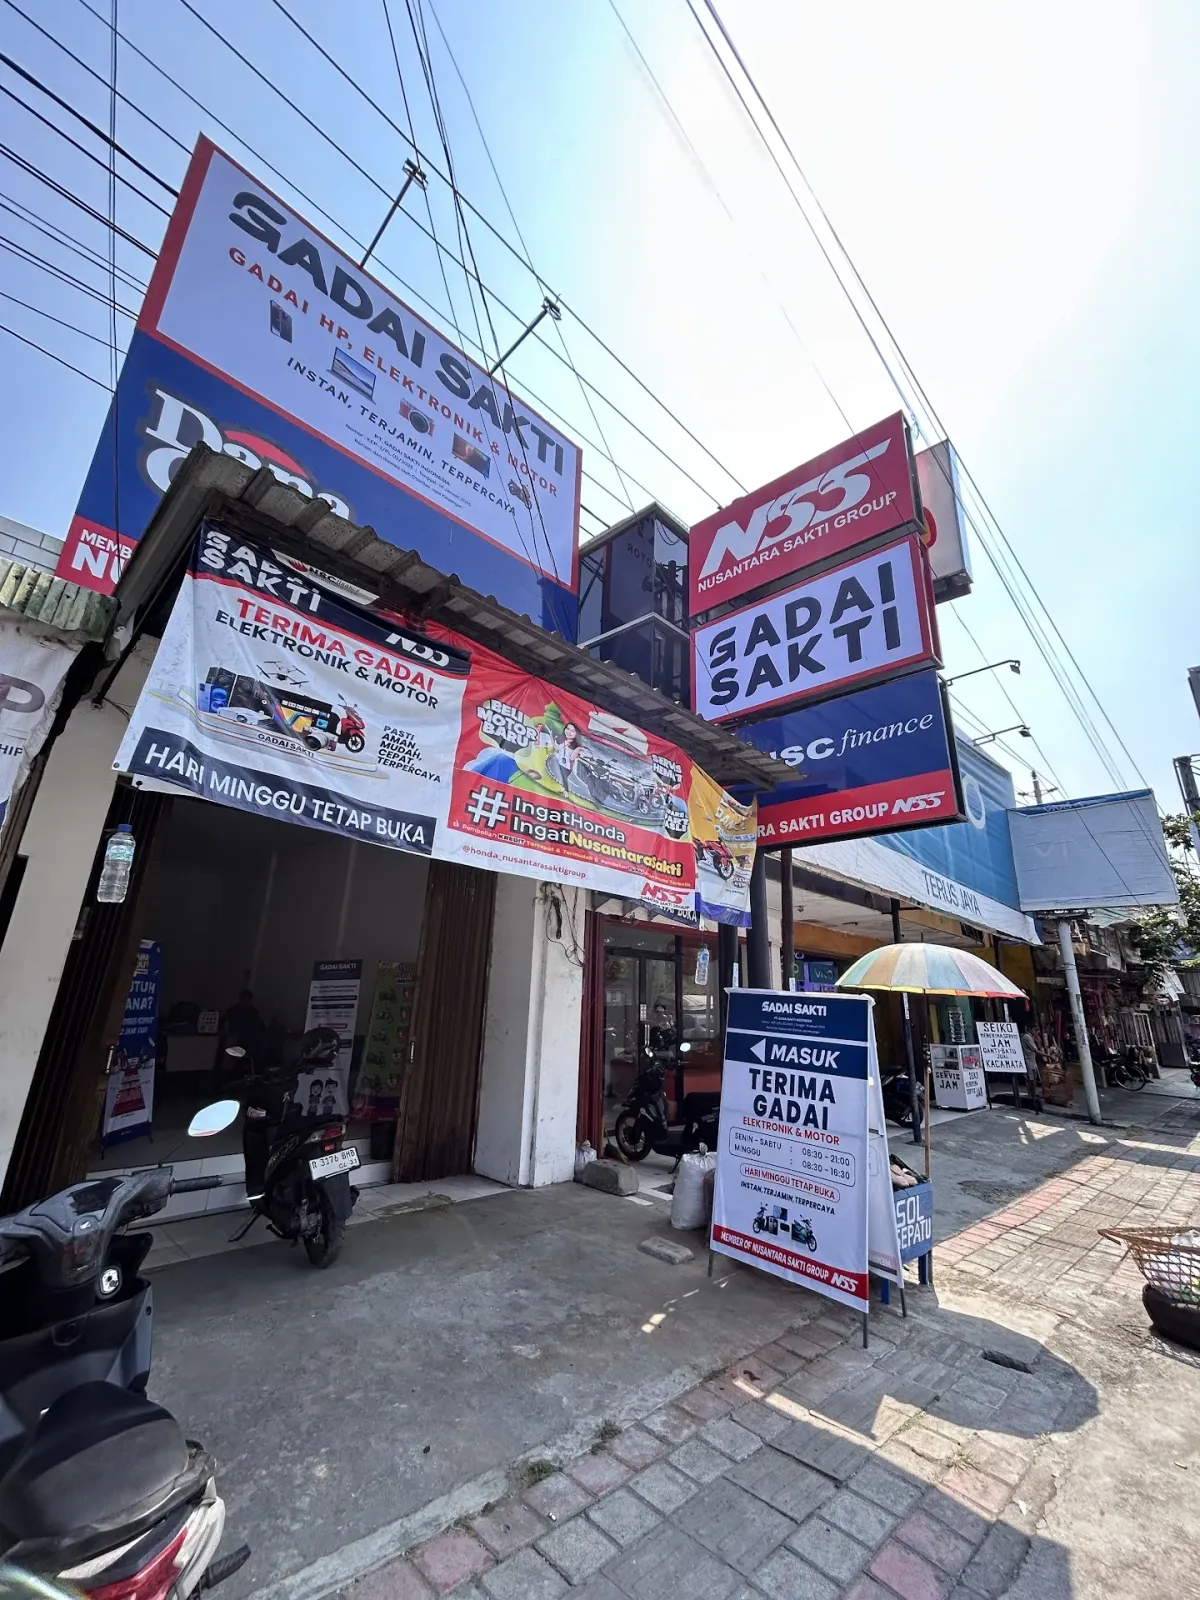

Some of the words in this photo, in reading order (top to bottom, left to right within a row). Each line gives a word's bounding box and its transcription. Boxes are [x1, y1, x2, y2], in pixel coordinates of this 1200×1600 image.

[229, 247, 309, 315] GADAI
[319, 313, 353, 350] HP,
[363, 345, 484, 444] ELEKTRONIK
[490, 441, 500, 456] &
[507, 452, 558, 498] MOTOR
[434, 352, 564, 477] SAKTI
[286, 357, 353, 409] INSTAN,
[359, 405, 436, 464] TERJAMIN,
[441, 459, 517, 518] TERPERCAYA
[697, 545, 781, 593] NUSANTARA
[783, 523, 830, 553] SAKTI
[833, 490, 897, 529] GROUP
[199, 548, 322, 613] SAKTI
[307, 566, 339, 584] NSC
[215, 609, 350, 674] ELEKTRONIK
[354, 666, 371, 682] &
[374, 672, 440, 710] MOTOR
[237, 597, 347, 658] TERIMA
[353, 648, 435, 693] GADAI
[708, 605, 902, 706] SAKTI
[476, 706, 537, 741] MOTOR
[490, 699, 524, 724] BELI
[257, 732, 289, 751] GADAI
[383, 724, 415, 741] PASTI
[482, 720, 529, 748] BARU
[769, 737, 835, 768] SC
[836, 713, 934, 756] finance
[376, 756, 442, 784] TERPERCAYA
[145, 743, 205, 785] HARI
[210, 770, 307, 816] MINGGU
[312, 798, 373, 831] TETAP
[375, 815, 426, 845] BUKA
[461, 823, 498, 839] Pembelian
[498, 834, 525, 845] KREDIT
[514, 797, 626, 843] IngatHonda
[779, 812, 825, 834] SAKTI
[829, 802, 889, 825] GROUP
[462, 844, 587, 880] @honda_nusantarasaktigroup
[920, 869, 959, 908] TERUS
[959, 888, 983, 917] JAYA
[794, 1003, 827, 1017] SAKTI
[983, 1022, 1013, 1033] SEIKO
[990, 1039, 1011, 1048] JAM
[770, 1044, 841, 1069] MASUK
[985, 1059, 1025, 1070] KACAMATA
[748, 1068, 836, 1104] TERIMA
[935, 1071, 960, 1080] SERVIS
[939, 1080, 959, 1090] JAM
[753, 1094, 829, 1130] GADAI
[742, 1116, 793, 1136] ELEKTRONIK
[795, 1127, 803, 1138] &
[804, 1130, 840, 1146] MOTOR
[311, 1160, 318, 1170] R
[734, 1132, 754, 1143] SENIN
[759, 1138, 782, 1150] SABTU
[830, 1154, 850, 1167] 21:00
[734, 1143, 761, 1157] MINGGU
[744, 1167, 760, 1177] HARI
[760, 1170, 790, 1185] MINGGU
[791, 1177, 814, 1194] TETAP
[814, 1187, 835, 1200] BUKA
[896, 1195, 925, 1227] SOL
[720, 1231, 745, 1248] MEMBER
[745, 1238, 752, 1249] OF
[751, 1241, 787, 1265] NUSANTARA
[786, 1254, 806, 1272] SAKTI
[806, 1263, 830, 1281] GROUP
